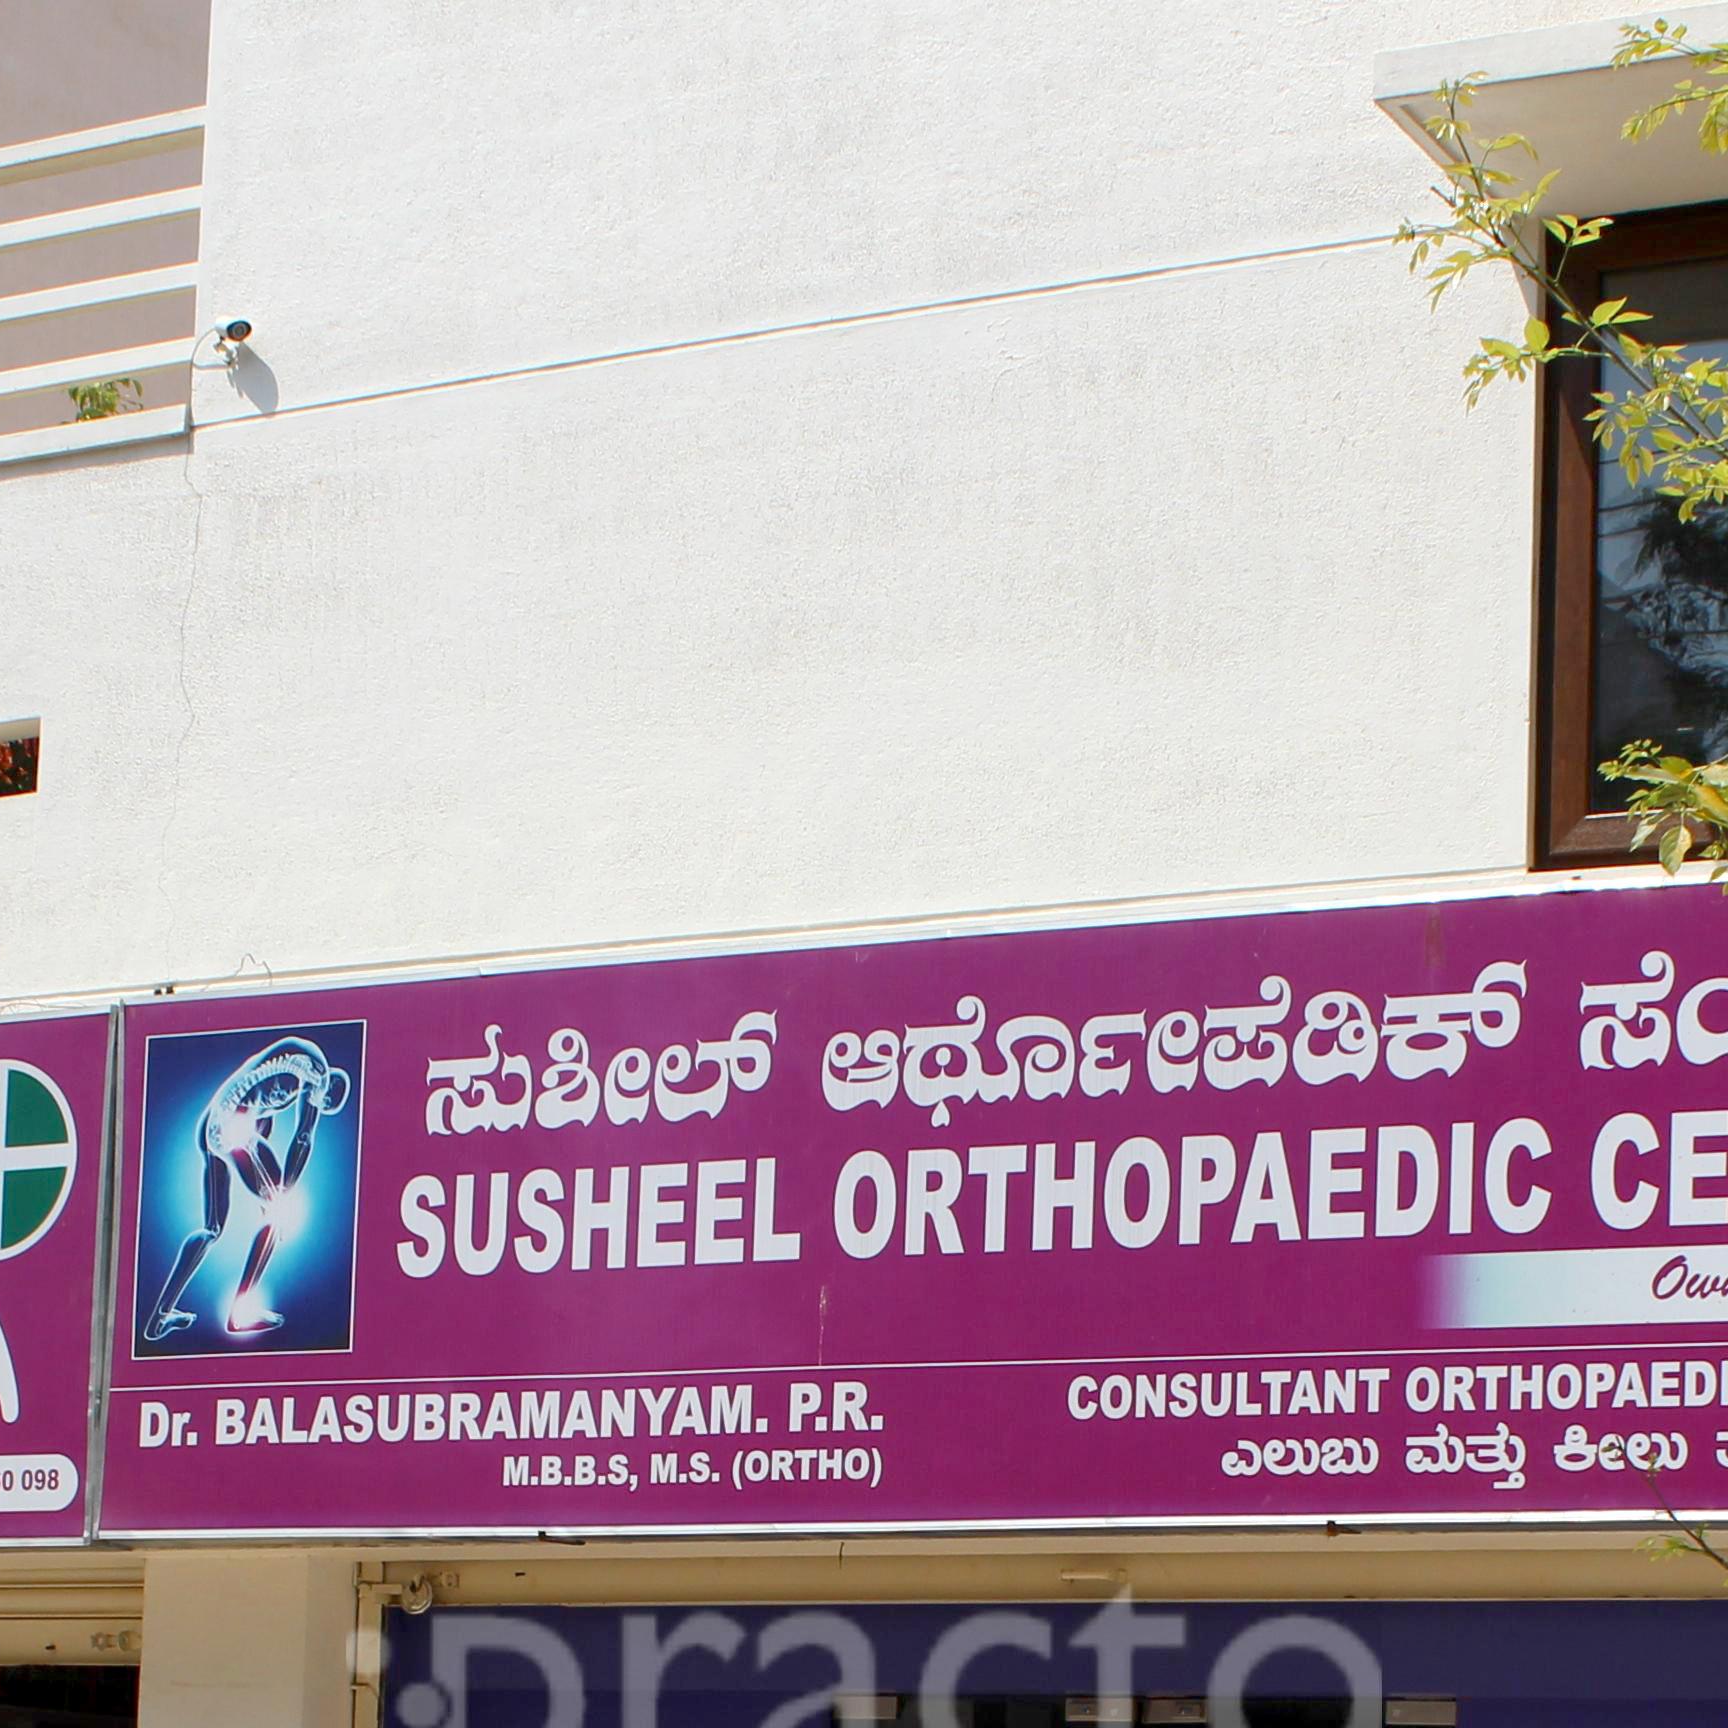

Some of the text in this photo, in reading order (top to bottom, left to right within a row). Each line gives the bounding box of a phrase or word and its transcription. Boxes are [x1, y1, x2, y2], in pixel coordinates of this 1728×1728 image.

[425, 1008, 779, 1136] ಸುಶೀಲ್
[396, 1157, 801, 1278] SUSHEEL
[833, 1116, 1553, 1259] ORTHOPAEDIC
[138, 1381, 884, 1448] Dr. BALASUBRAMANYAM. P.R.
[1067, 1366, 1390, 1422] CONSULTANT
[21, 1468, 60, 1491] 098
[503, 1448, 883, 1492] M.B.B.S, M.S. (ORTHO)
[1221, 1434, 1380, 1477] ಎಲುಬು
[1404, 1422, 1528, 1490] ಮತ್ತು
